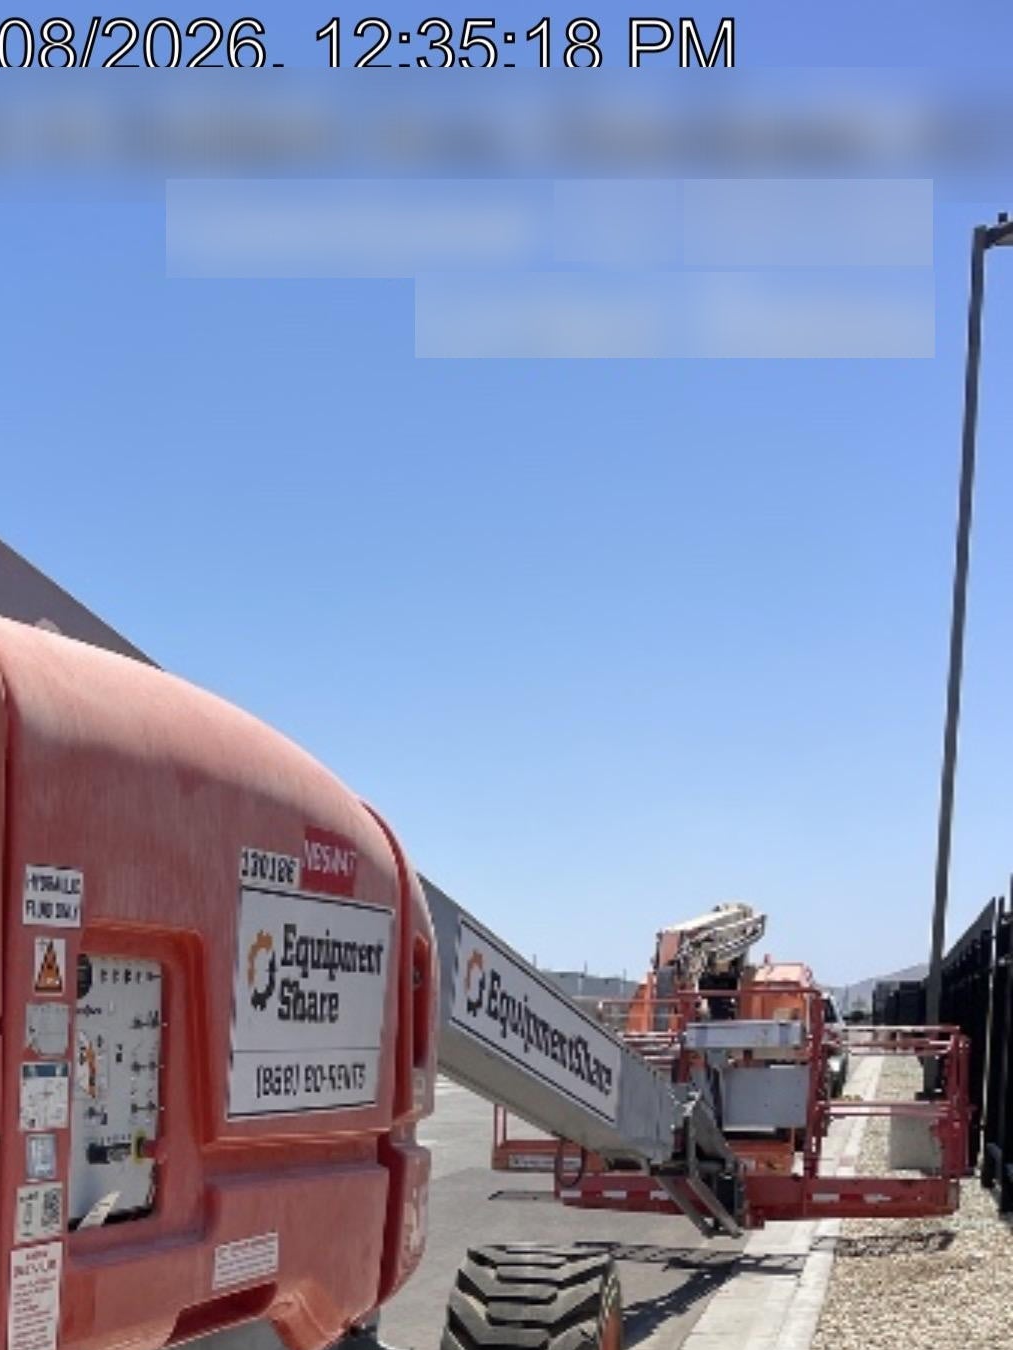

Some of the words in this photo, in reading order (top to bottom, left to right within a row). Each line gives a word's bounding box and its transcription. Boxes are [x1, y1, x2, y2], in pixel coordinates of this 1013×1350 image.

[280, 923, 384, 981] Equipment
[278, 977, 339, 1024] Share
[485, 968, 613, 1096] EquipmentShare
